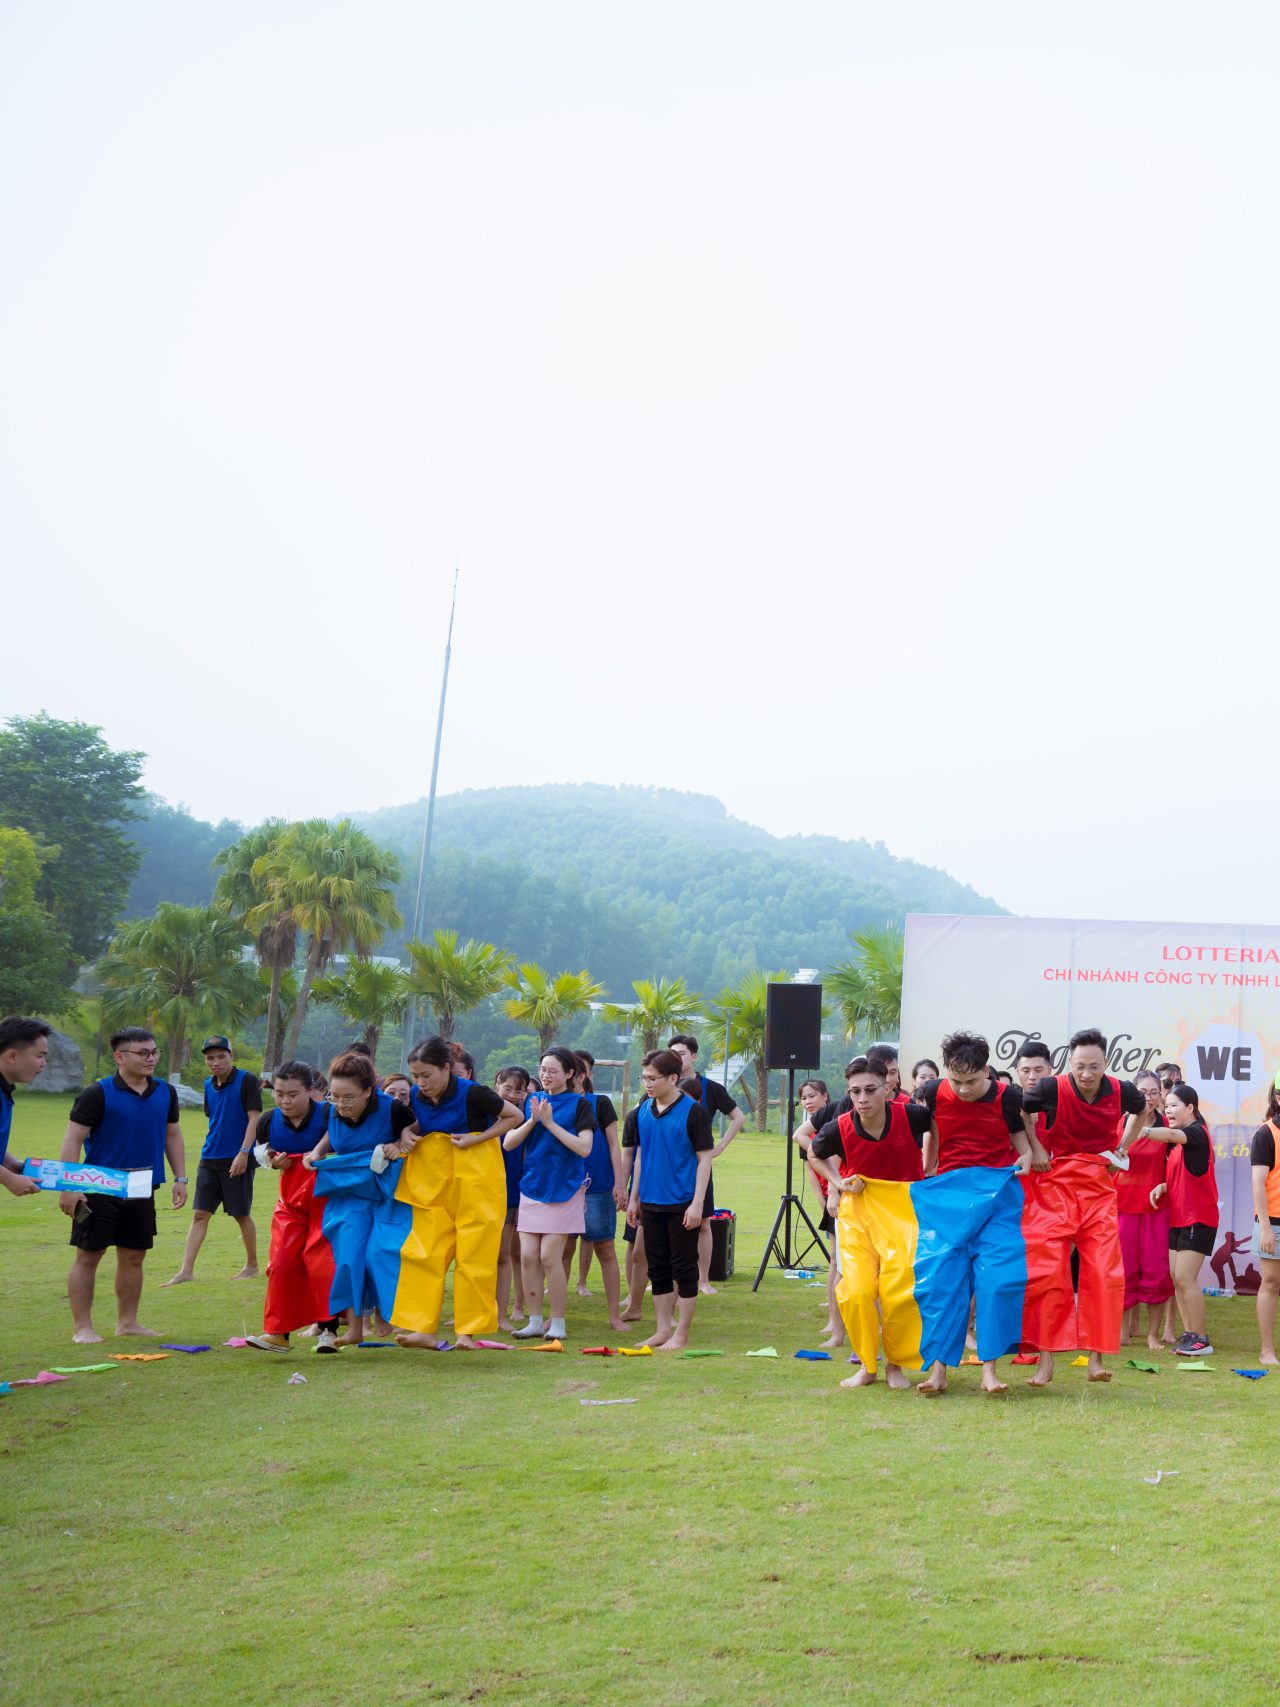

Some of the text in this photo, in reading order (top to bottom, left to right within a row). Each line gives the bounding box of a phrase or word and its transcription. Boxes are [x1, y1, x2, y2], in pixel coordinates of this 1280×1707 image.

[1162, 945, 1280, 963] LOTTERIA
[1043, 968, 1072, 981] CHI
[1077, 967, 1139, 983] NHÁNH
[1144, 969, 1193, 985] CÔNG
[1197, 972, 1218, 985] TY
[1222, 973, 1269, 987] TNHH
[1196, 1045, 1252, 1082] WE
